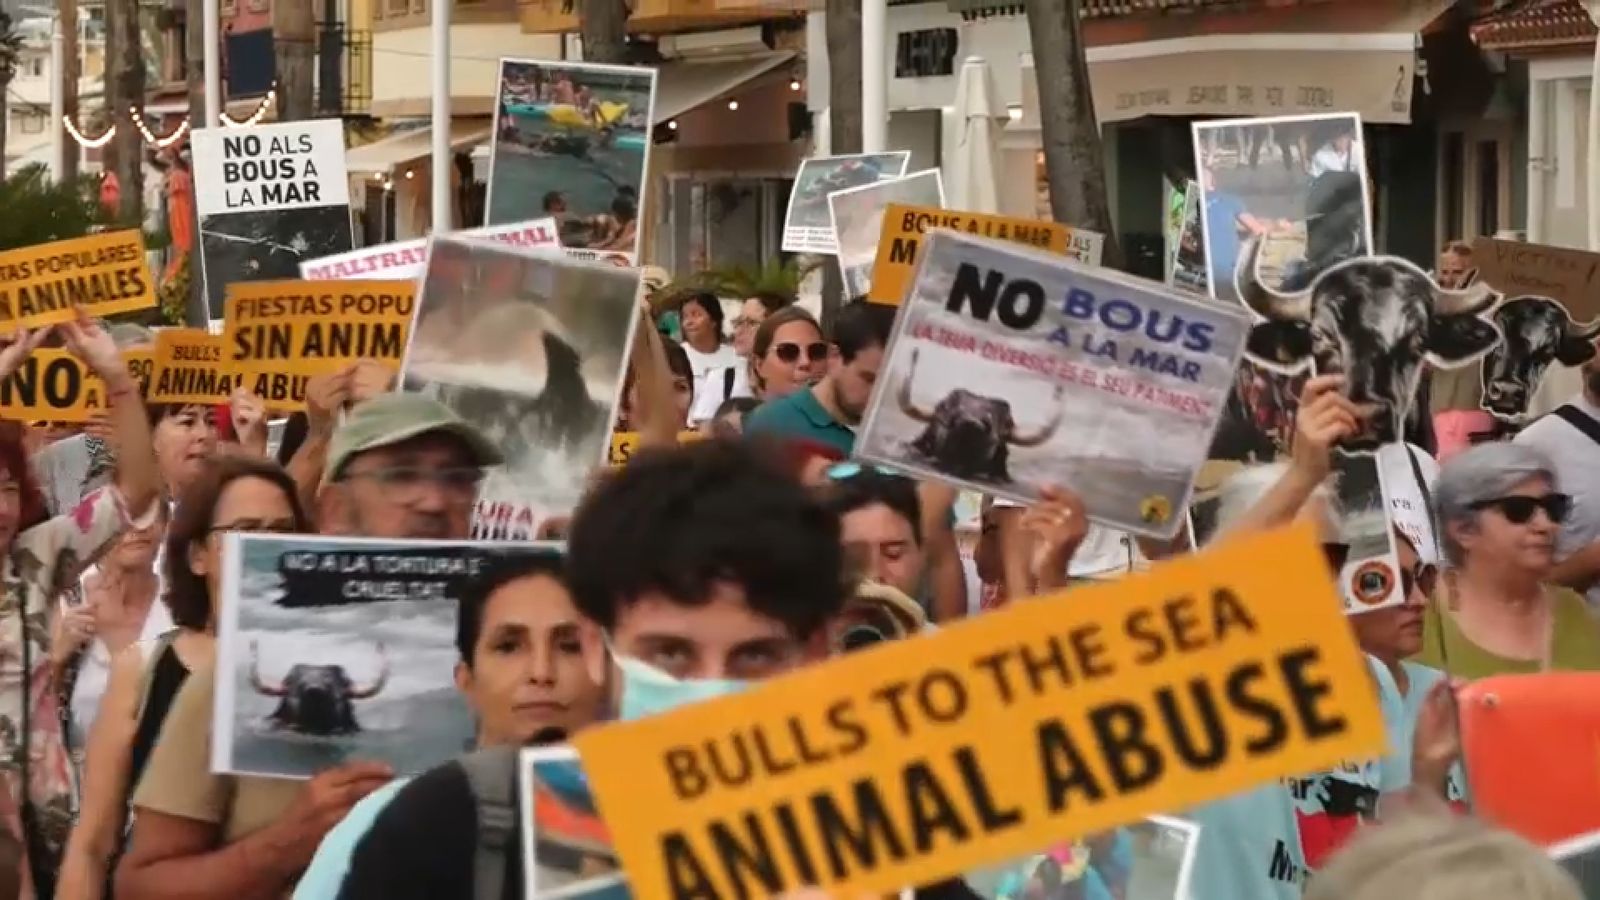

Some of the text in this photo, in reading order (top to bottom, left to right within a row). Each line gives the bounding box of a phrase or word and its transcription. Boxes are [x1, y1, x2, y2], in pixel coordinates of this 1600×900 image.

[223, 134, 313, 159] NO ALS
[223, 159, 318, 184] BOUS A
[226, 181, 320, 208] LA MAR
[34, 242, 139, 276] POPULARES
[18, 264, 147, 317] ANIMALES
[235, 294, 414, 322] FIESTAS POPU
[945, 261, 1216, 353] NO BOUS
[231, 322, 402, 361] SIN ANIM
[1046, 325, 1202, 382] A LA MAR
[0, 356, 81, 409] NO
[284, 553, 318, 571] NO
[320, 554, 338, 573] A
[341, 554, 369, 573] LA
[662, 586, 1260, 801] BULLS TO THE SEA
[656, 643, 1350, 900] ANIMAL ABUSE
